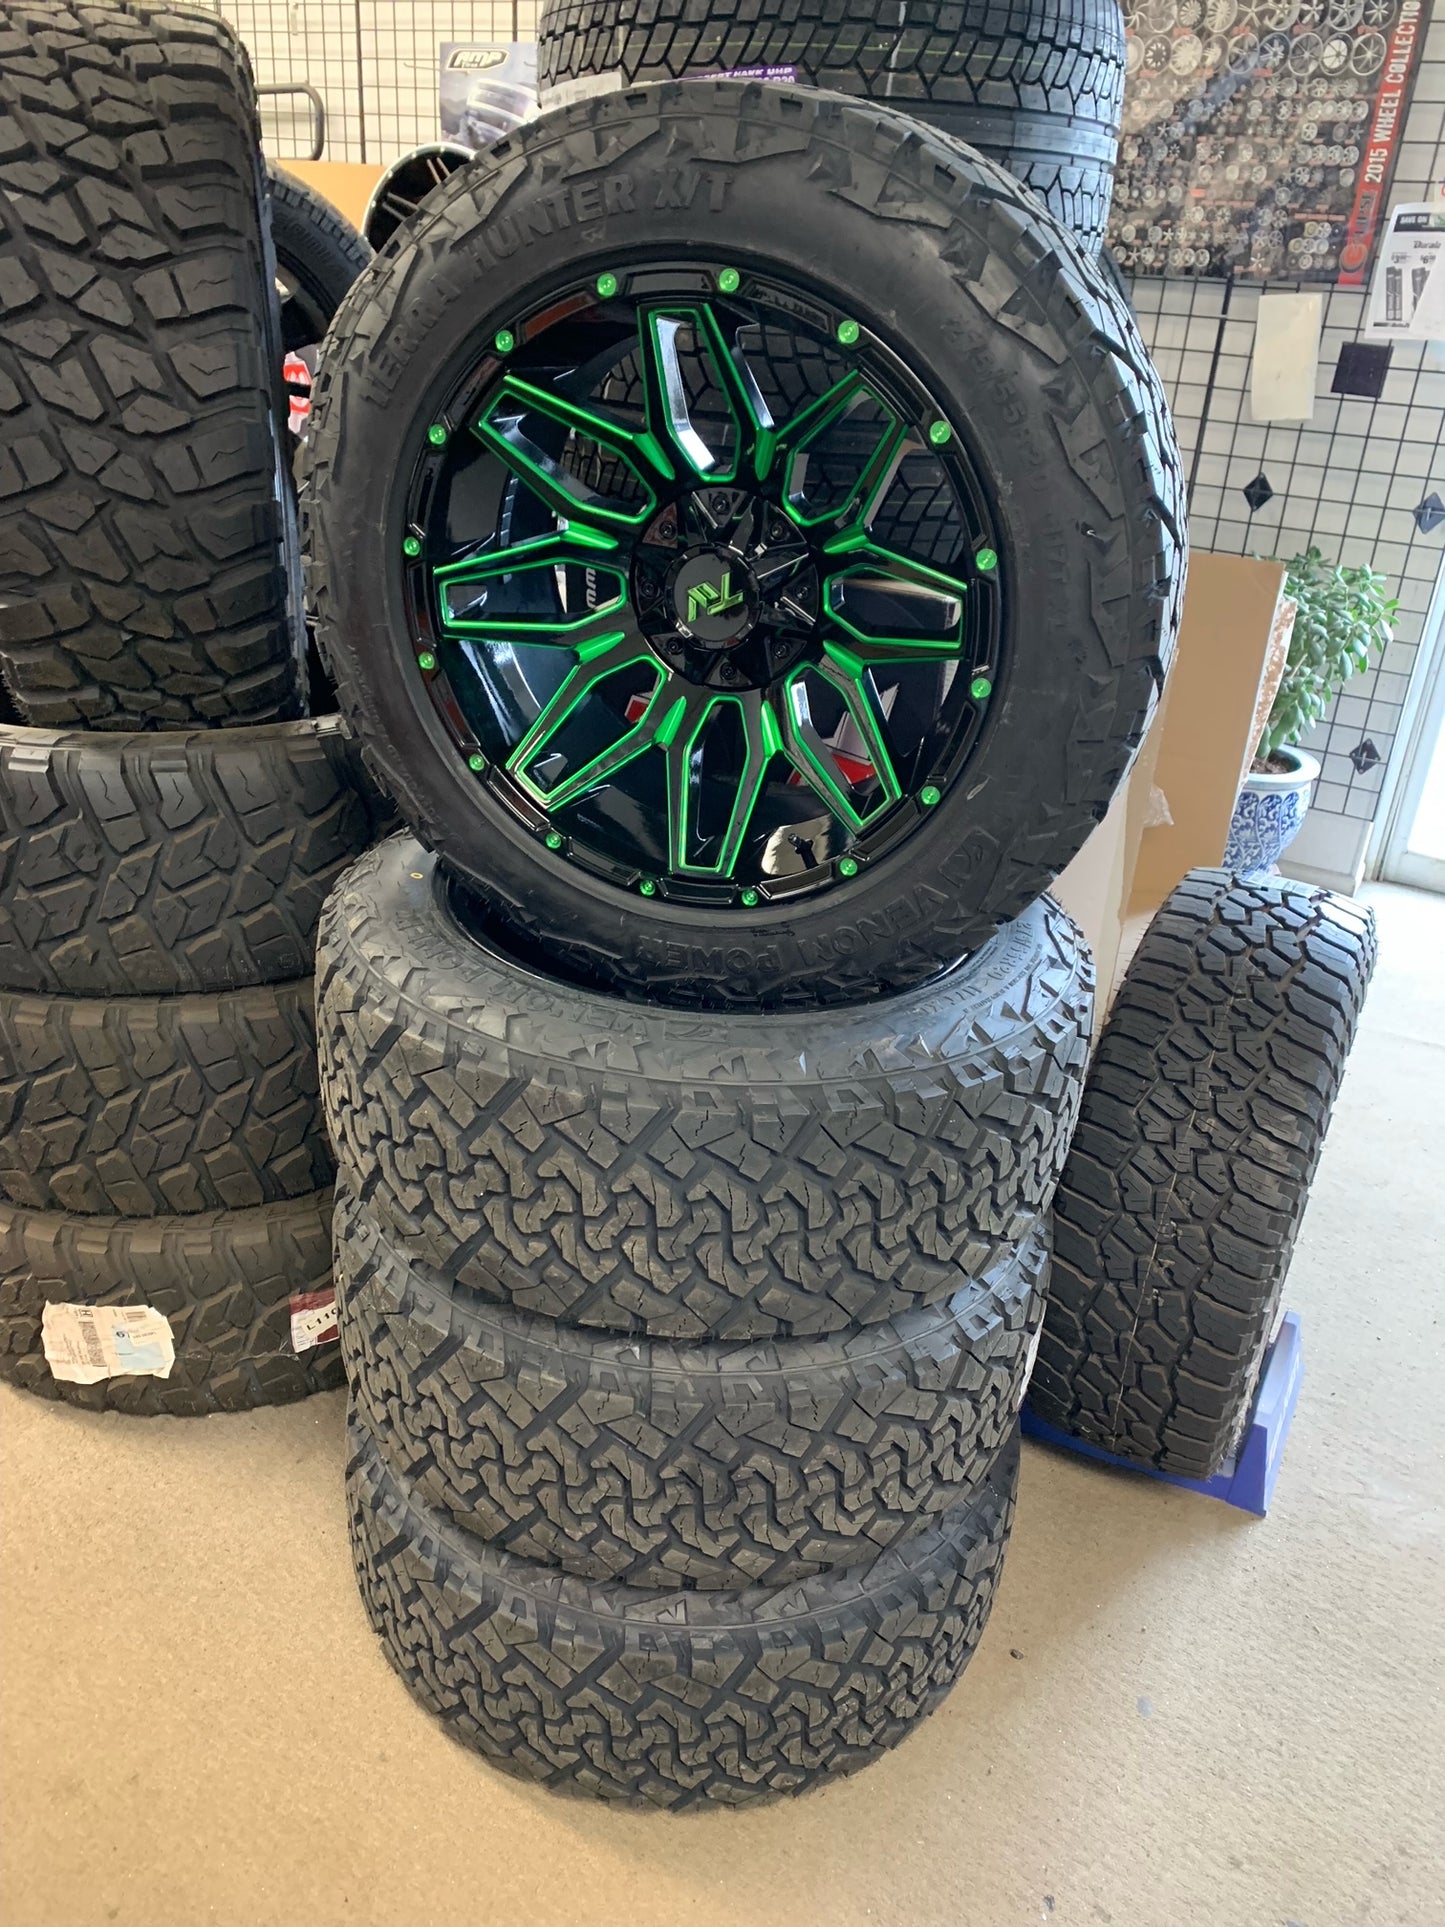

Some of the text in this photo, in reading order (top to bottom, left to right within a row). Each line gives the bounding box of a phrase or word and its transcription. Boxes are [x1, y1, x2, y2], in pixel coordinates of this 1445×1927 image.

[766, 67, 793, 75] UHP
[1373, 89, 1402, 143] WHEEL
[1364, 148, 1388, 183] 2015
[360, 273, 460, 409] TERRA
[460, 173, 637, 281] HUNTER
[653, 167, 735, 213] X/T
[638, 880, 950, 974] VENOM POWER
